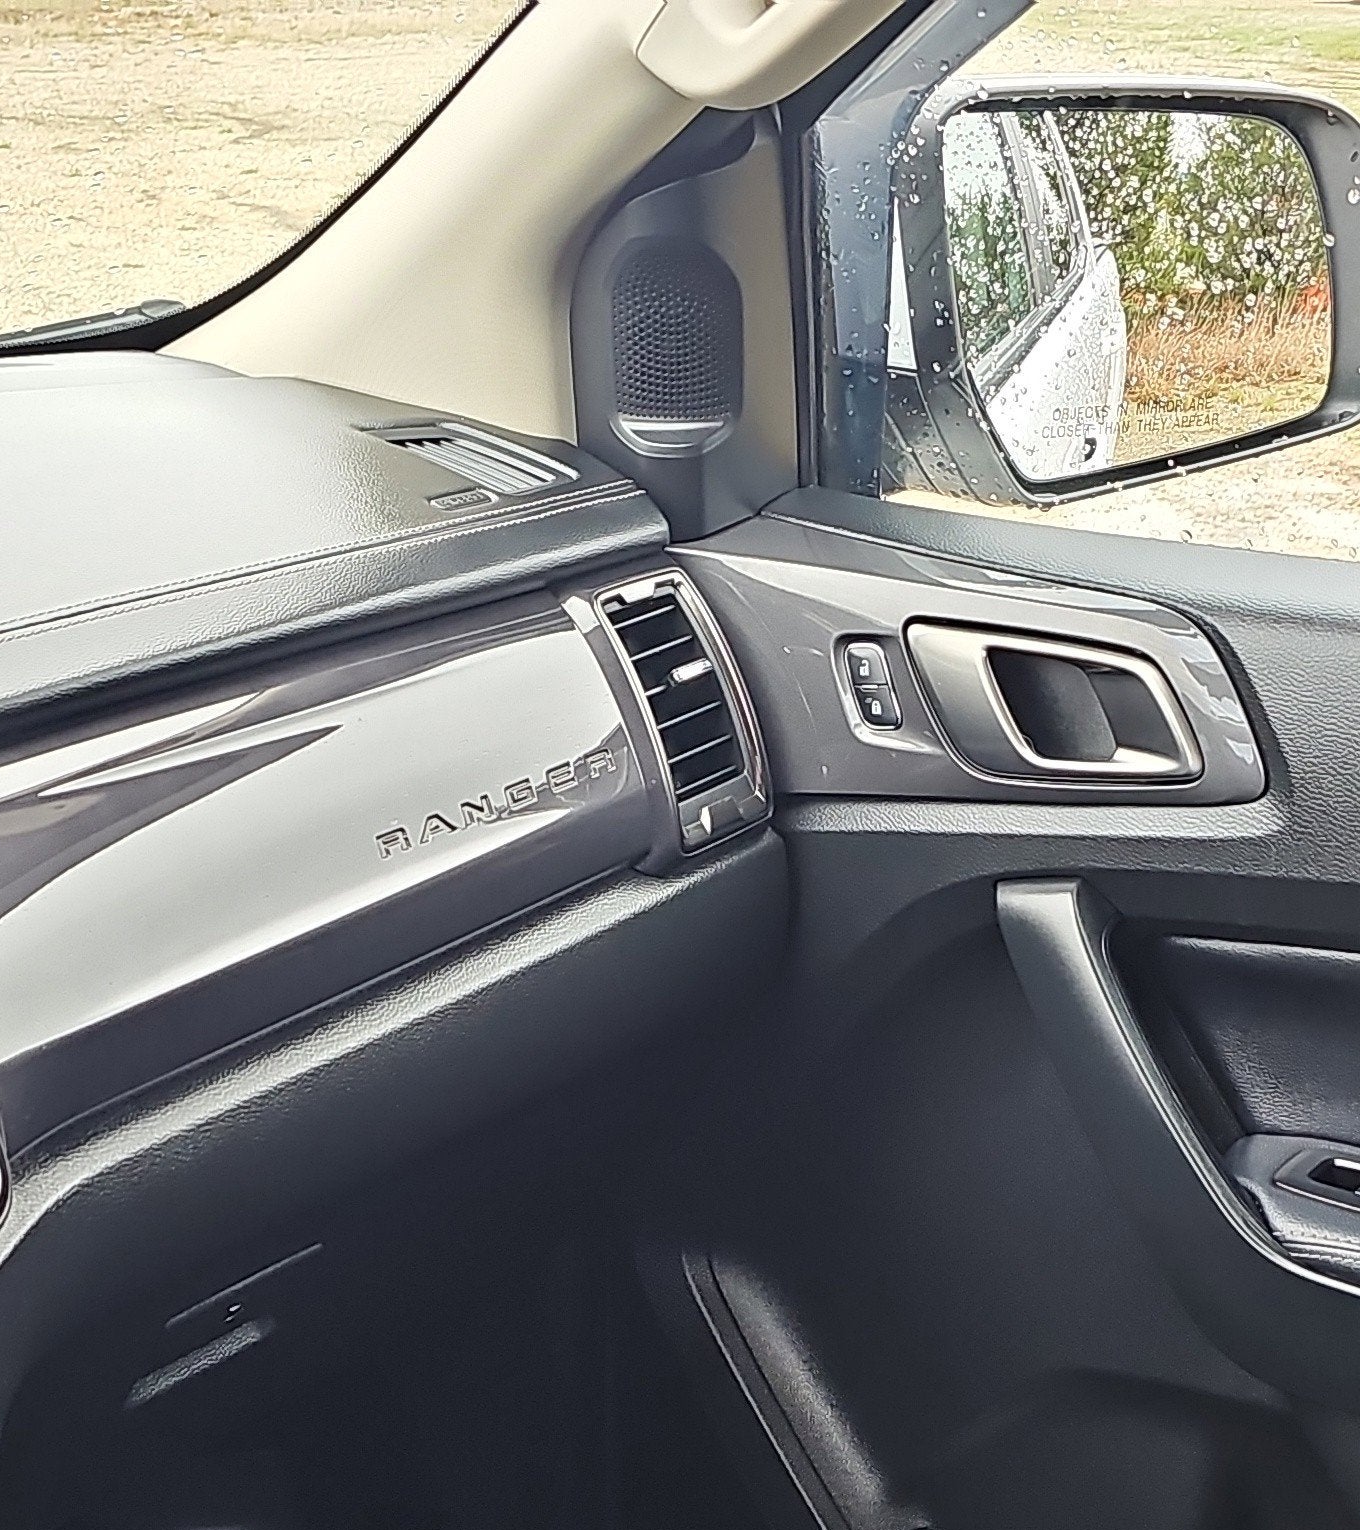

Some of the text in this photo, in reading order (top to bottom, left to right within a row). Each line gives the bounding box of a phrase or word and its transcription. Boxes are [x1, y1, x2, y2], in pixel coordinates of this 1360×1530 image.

[1052, 404, 1112, 422] OBJECTS
[1135, 399, 1185, 416] MIRROR
[1189, 398, 1215, 412] ARE
[1041, 412, 1221, 439] CLOSER THAN THEY APPEAR
[374, 747, 618, 860] RANGER
